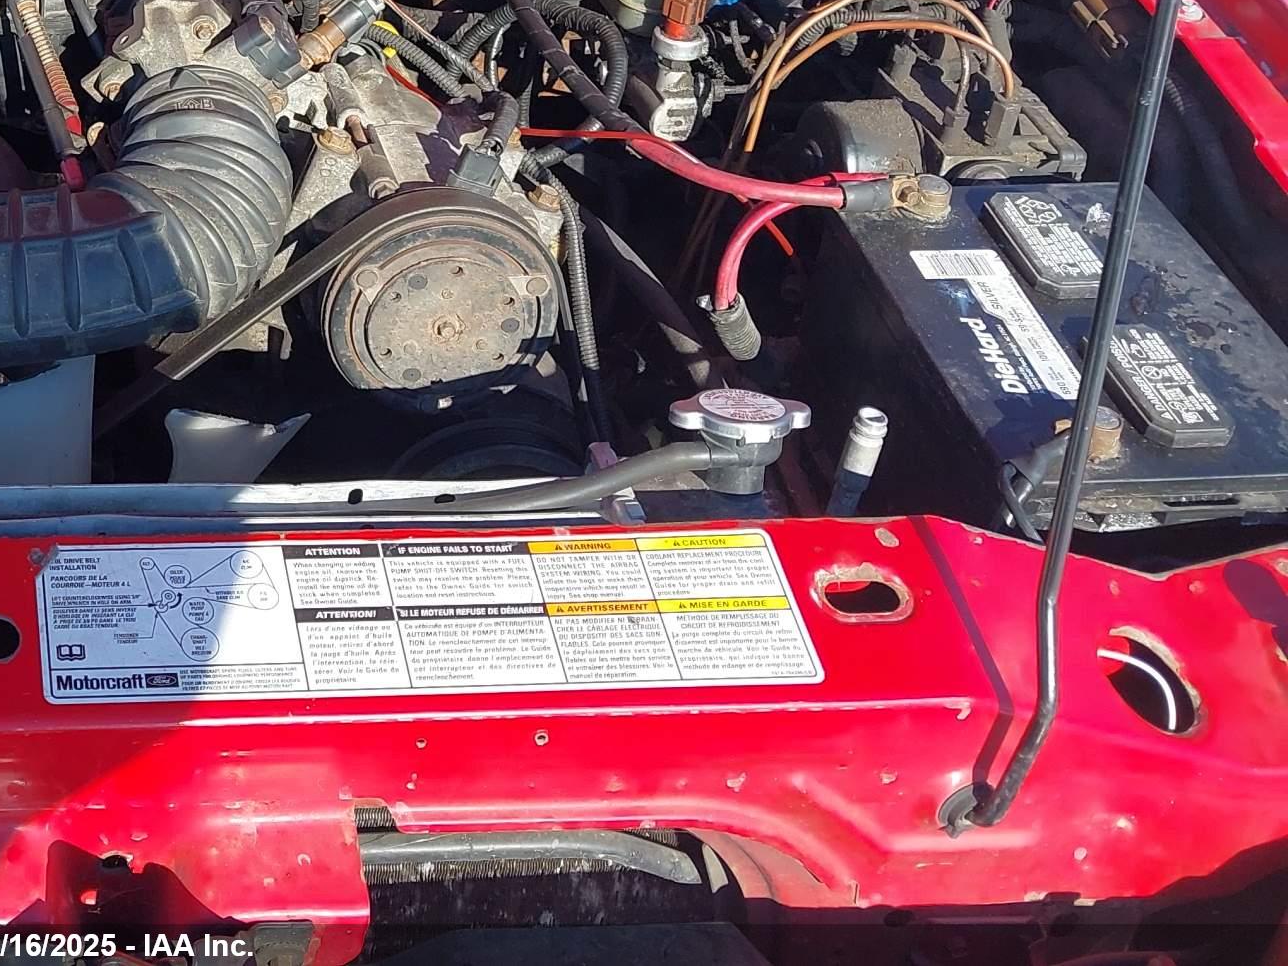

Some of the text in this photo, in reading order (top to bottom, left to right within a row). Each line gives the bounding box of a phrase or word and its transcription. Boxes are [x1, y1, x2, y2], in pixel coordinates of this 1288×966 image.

[977, 281, 1003, 310] SILVER
[960, 317, 1029, 394] DieHard
[1132, 376, 1166, 411] DANGER
[305, 548, 361, 556] ATTENTION
[408, 546, 442, 554] ENGINE
[470, 545, 483, 553] TO
[485, 545, 512, 553] START
[400, 609, 408, 617] SI
[421, 608, 454, 616] MOTEUR
[456, 607, 485, 615] REFUSE
[499, 605, 544, 614] DÉMARRER
[567, 604, 648, 612] AVERTISSEMENT
[315, 610, 376, 619] ATTENTION!
[56, 675, 145, 691] Motorcraft
[153, 676, 171, 685] Ford
